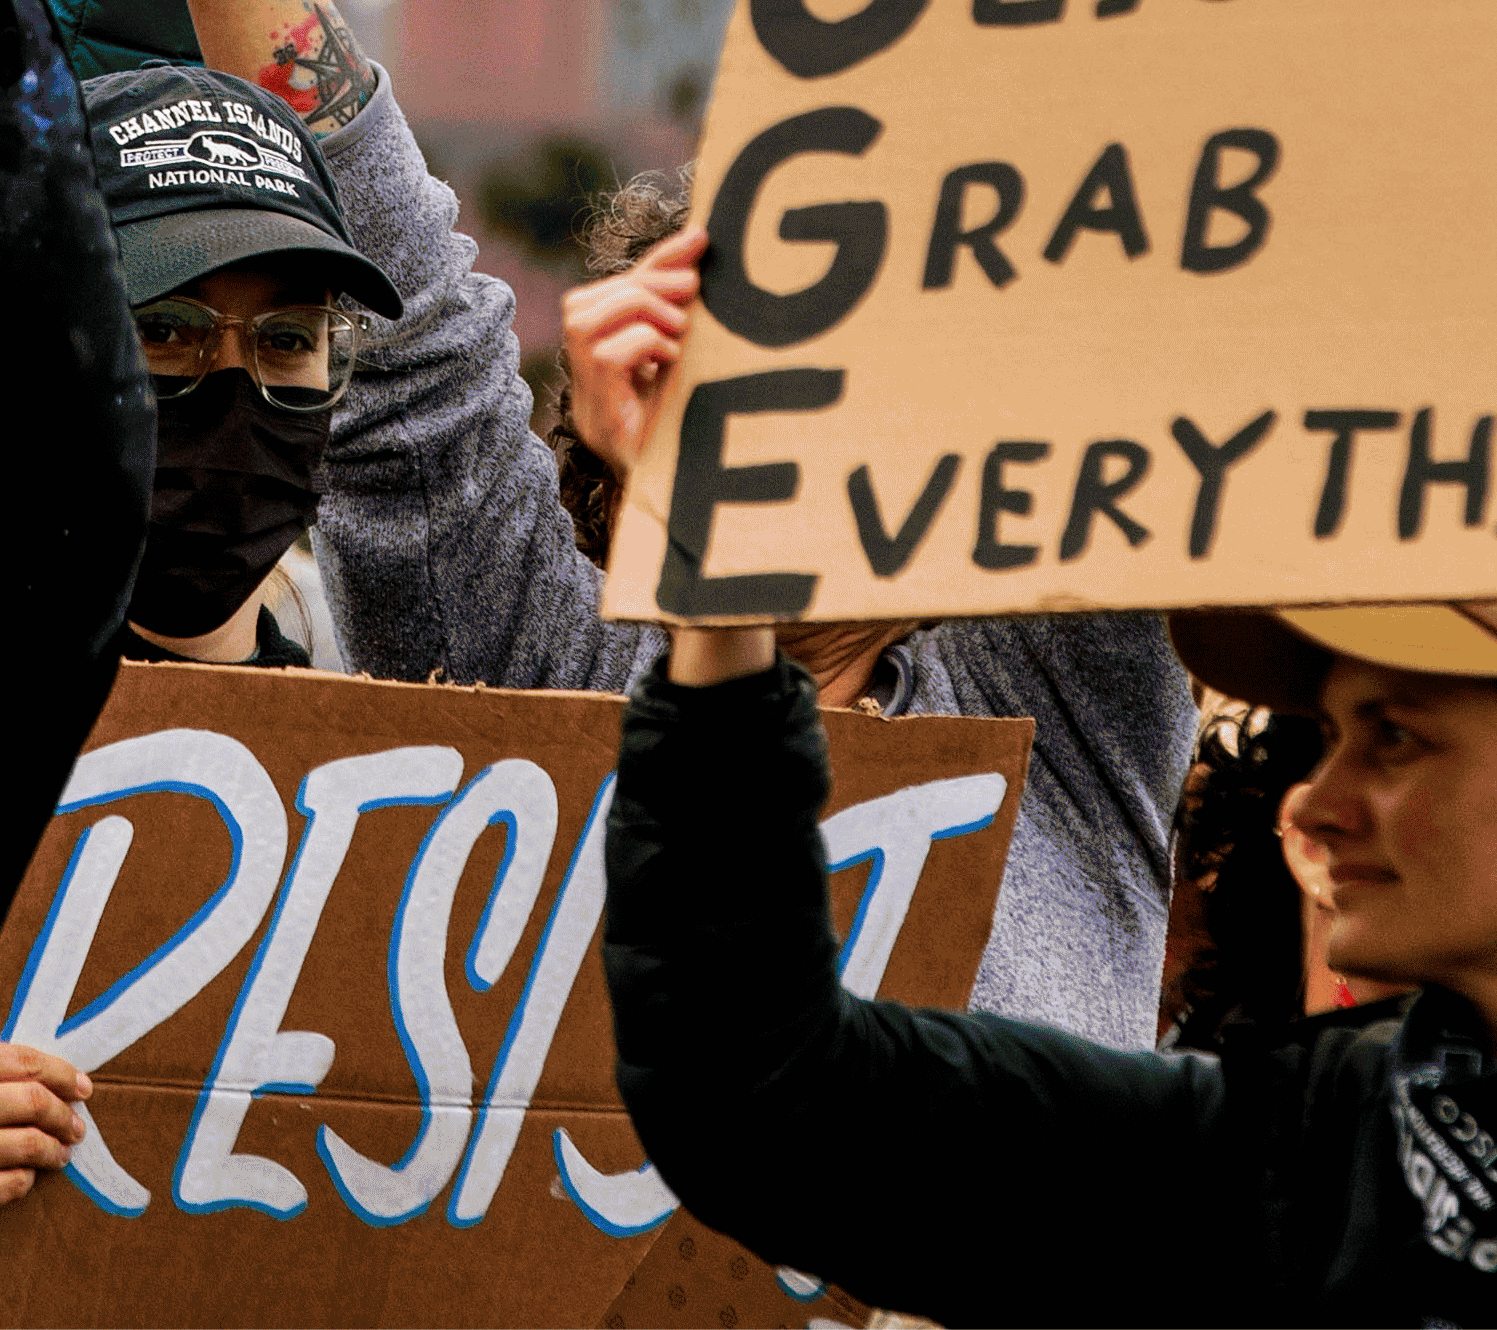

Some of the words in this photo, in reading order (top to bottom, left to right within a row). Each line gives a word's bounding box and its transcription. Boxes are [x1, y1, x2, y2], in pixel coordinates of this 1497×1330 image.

[109, 100, 222, 145] CHANNEL
[222, 101, 303, 163] ISLANDS
[126, 148, 180, 164] PROTECT
[148, 169, 251, 189] NATIONAL
[254, 174, 300, 199] PARK
[697, 105, 1282, 348] GRAB
[1, 727, 1007, 1301] RESIT
